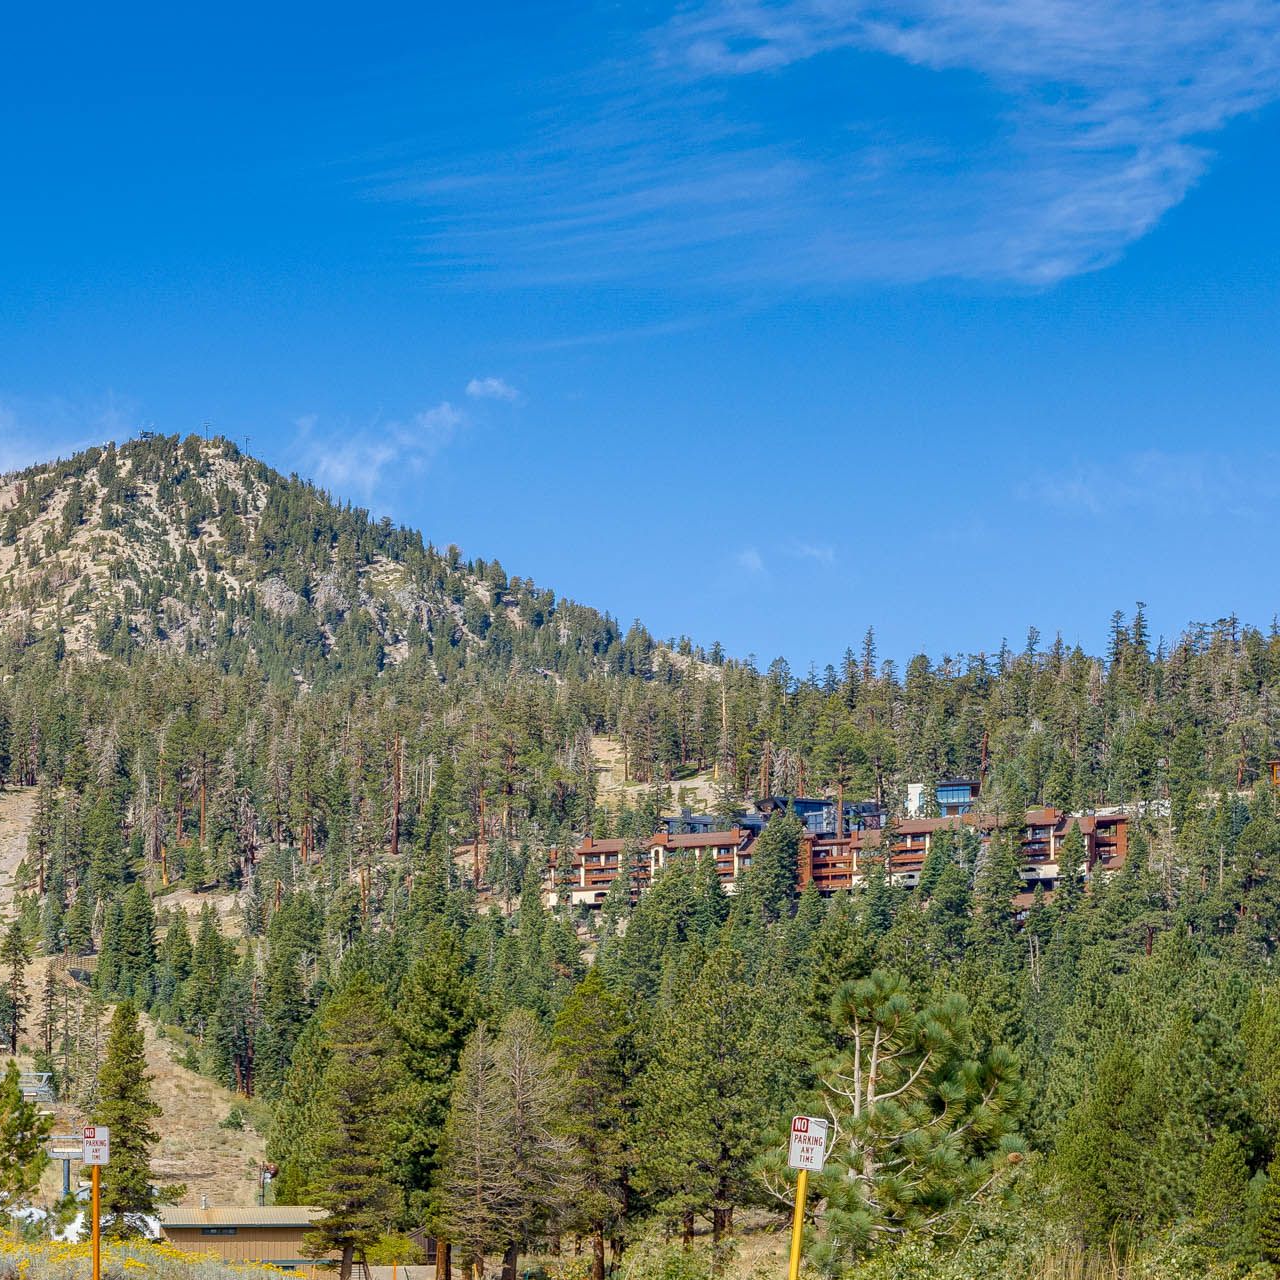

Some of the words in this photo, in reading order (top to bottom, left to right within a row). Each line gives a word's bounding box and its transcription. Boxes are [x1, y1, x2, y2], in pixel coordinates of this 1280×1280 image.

[795, 1119, 807, 1131] NO
[85, 1128, 95, 1137] NO
[794, 1134, 823, 1147] PARKING
[799, 1155, 814, 1163] TIME
